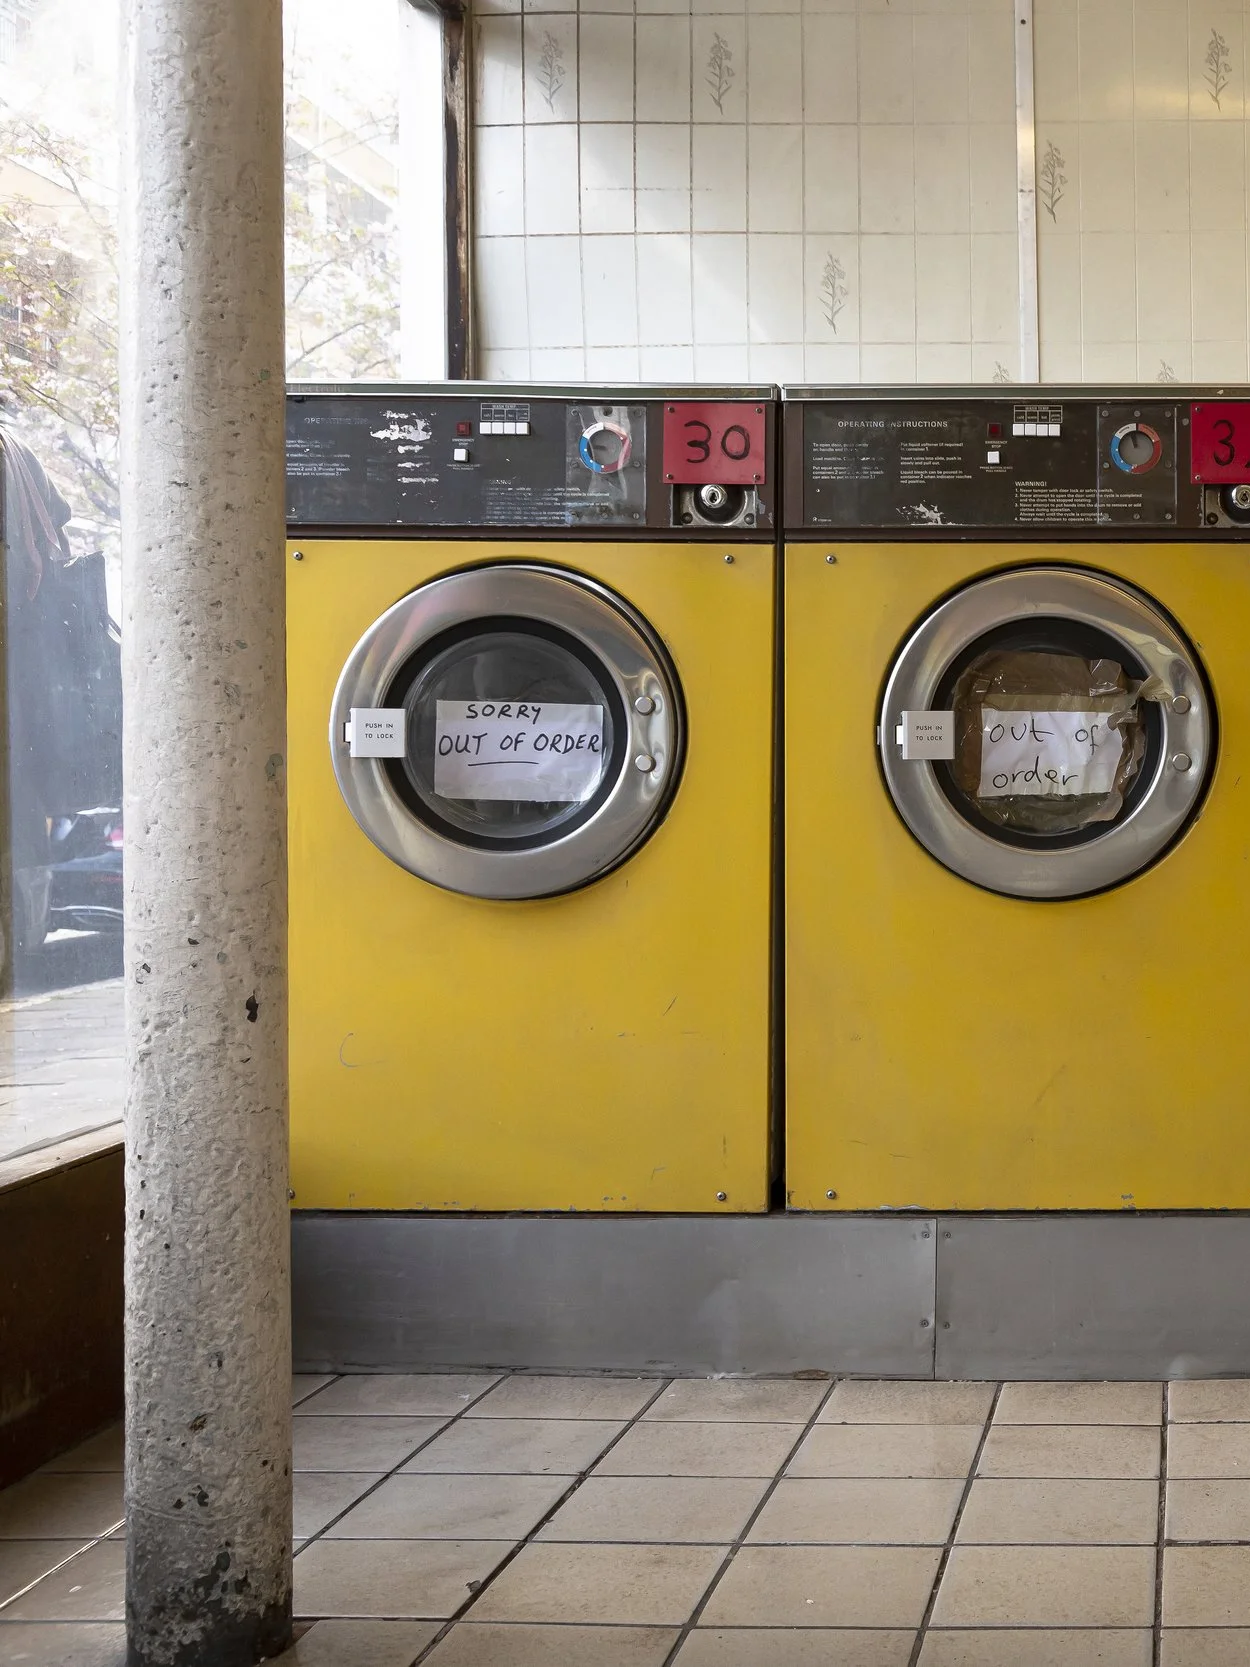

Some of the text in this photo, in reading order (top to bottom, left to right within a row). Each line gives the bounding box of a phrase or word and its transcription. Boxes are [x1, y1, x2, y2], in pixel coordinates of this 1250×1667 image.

[684, 420, 751, 463] 30
[466, 703, 542, 724] SORRY
[438, 732, 600, 756] OUT OF ORDER
[1074, 724, 1100, 756] of
[992, 756, 1079, 789] order
